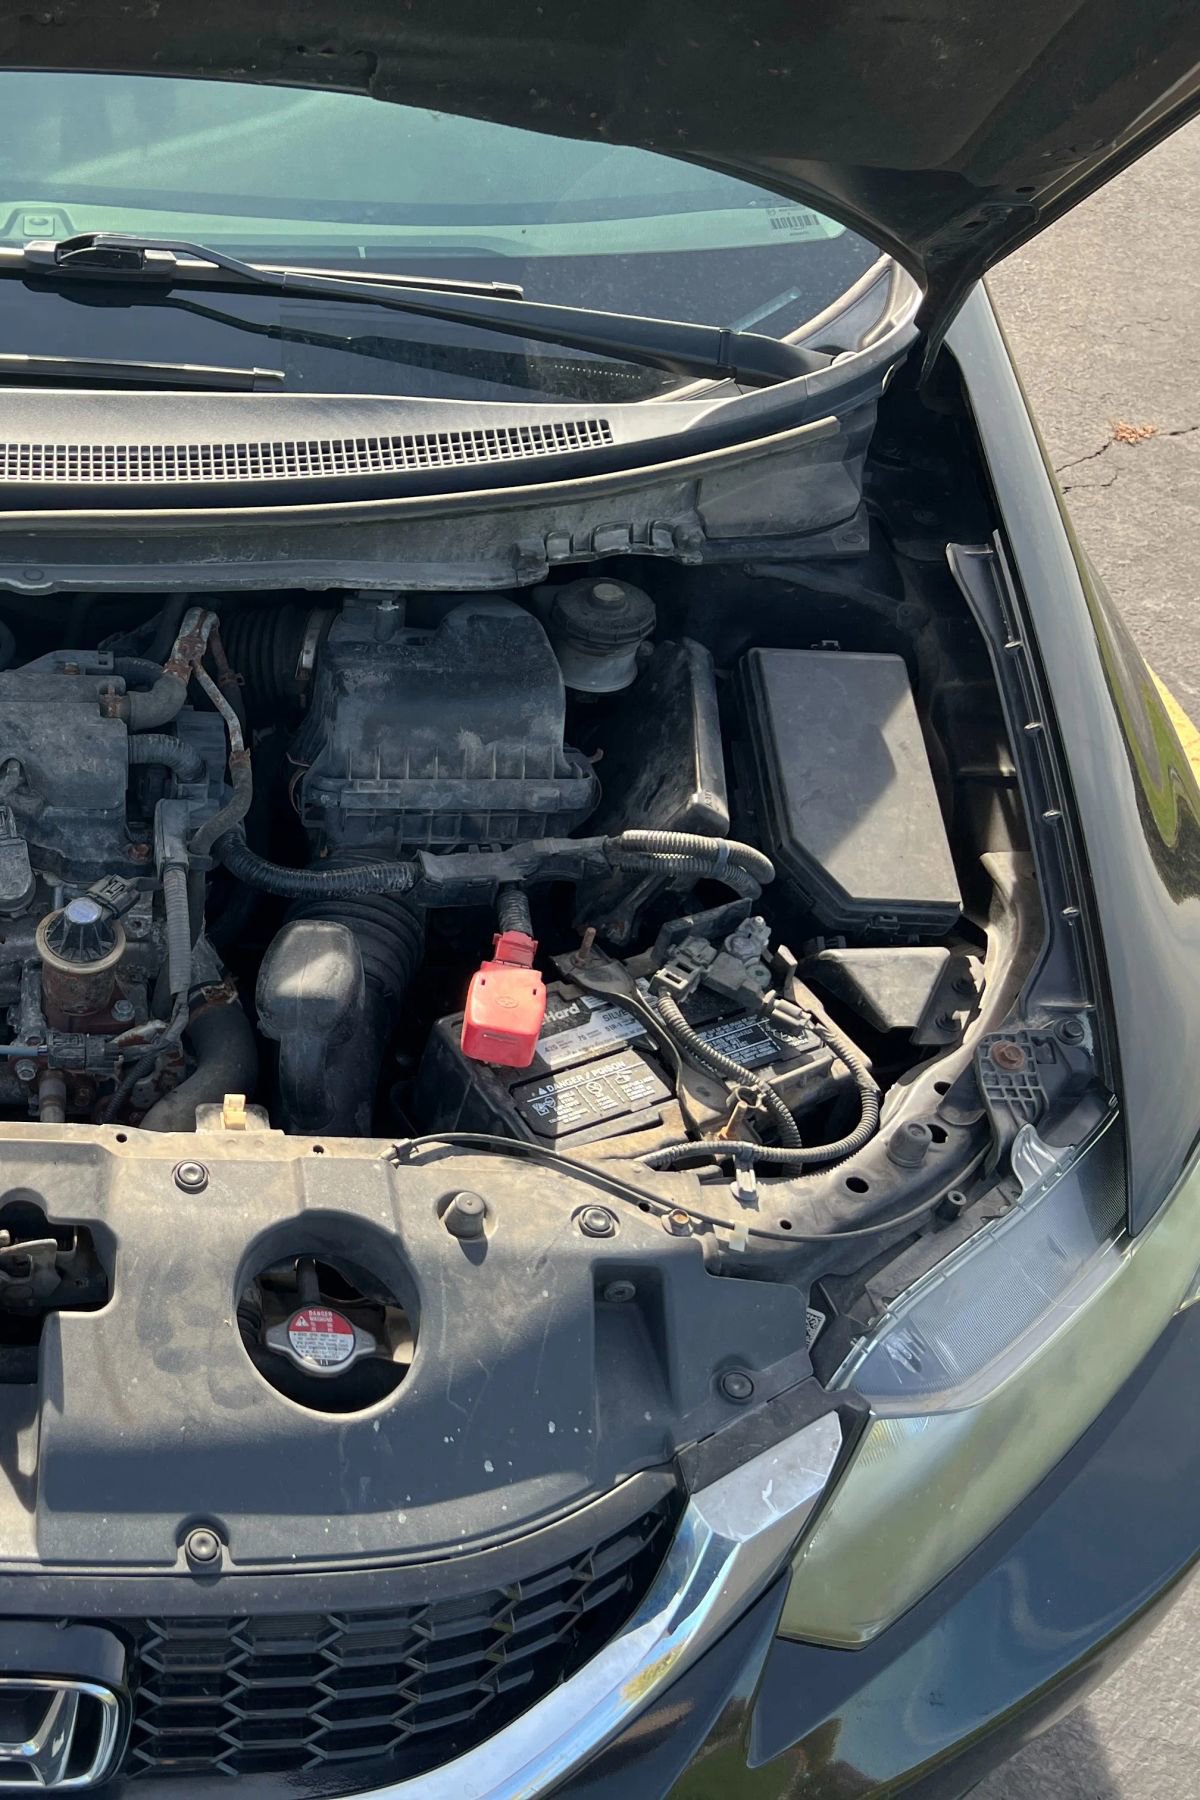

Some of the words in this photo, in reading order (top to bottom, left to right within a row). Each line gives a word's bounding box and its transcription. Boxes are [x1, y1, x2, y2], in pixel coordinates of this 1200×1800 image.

[543, 1002, 580, 1022] Hard
[602, 1009, 628, 1022] SILVE
[546, 1074, 585, 1092] DANGER
[591, 1061, 627, 1076] POISON
